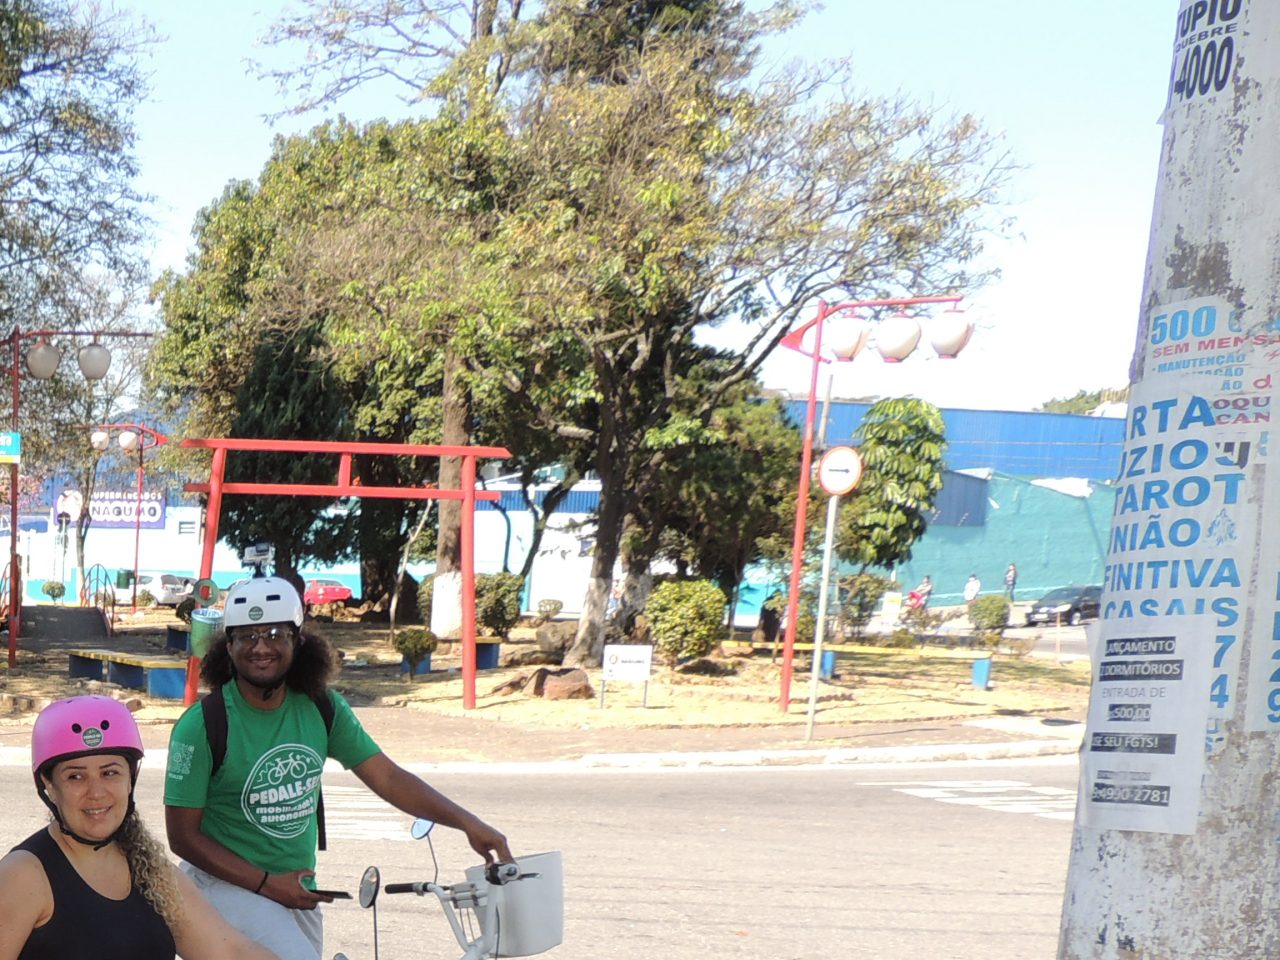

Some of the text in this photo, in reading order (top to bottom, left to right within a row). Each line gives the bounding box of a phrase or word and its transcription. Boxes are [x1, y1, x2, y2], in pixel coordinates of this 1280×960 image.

[1151, 306, 1217, 345] 500
[1152, 342, 1190, 359] SEM
[91, 506, 158, 518] NAGUMO
[1101, 687, 1167, 699] ENTRADA DE
[1124, 737, 1159, 749] FGTS!
